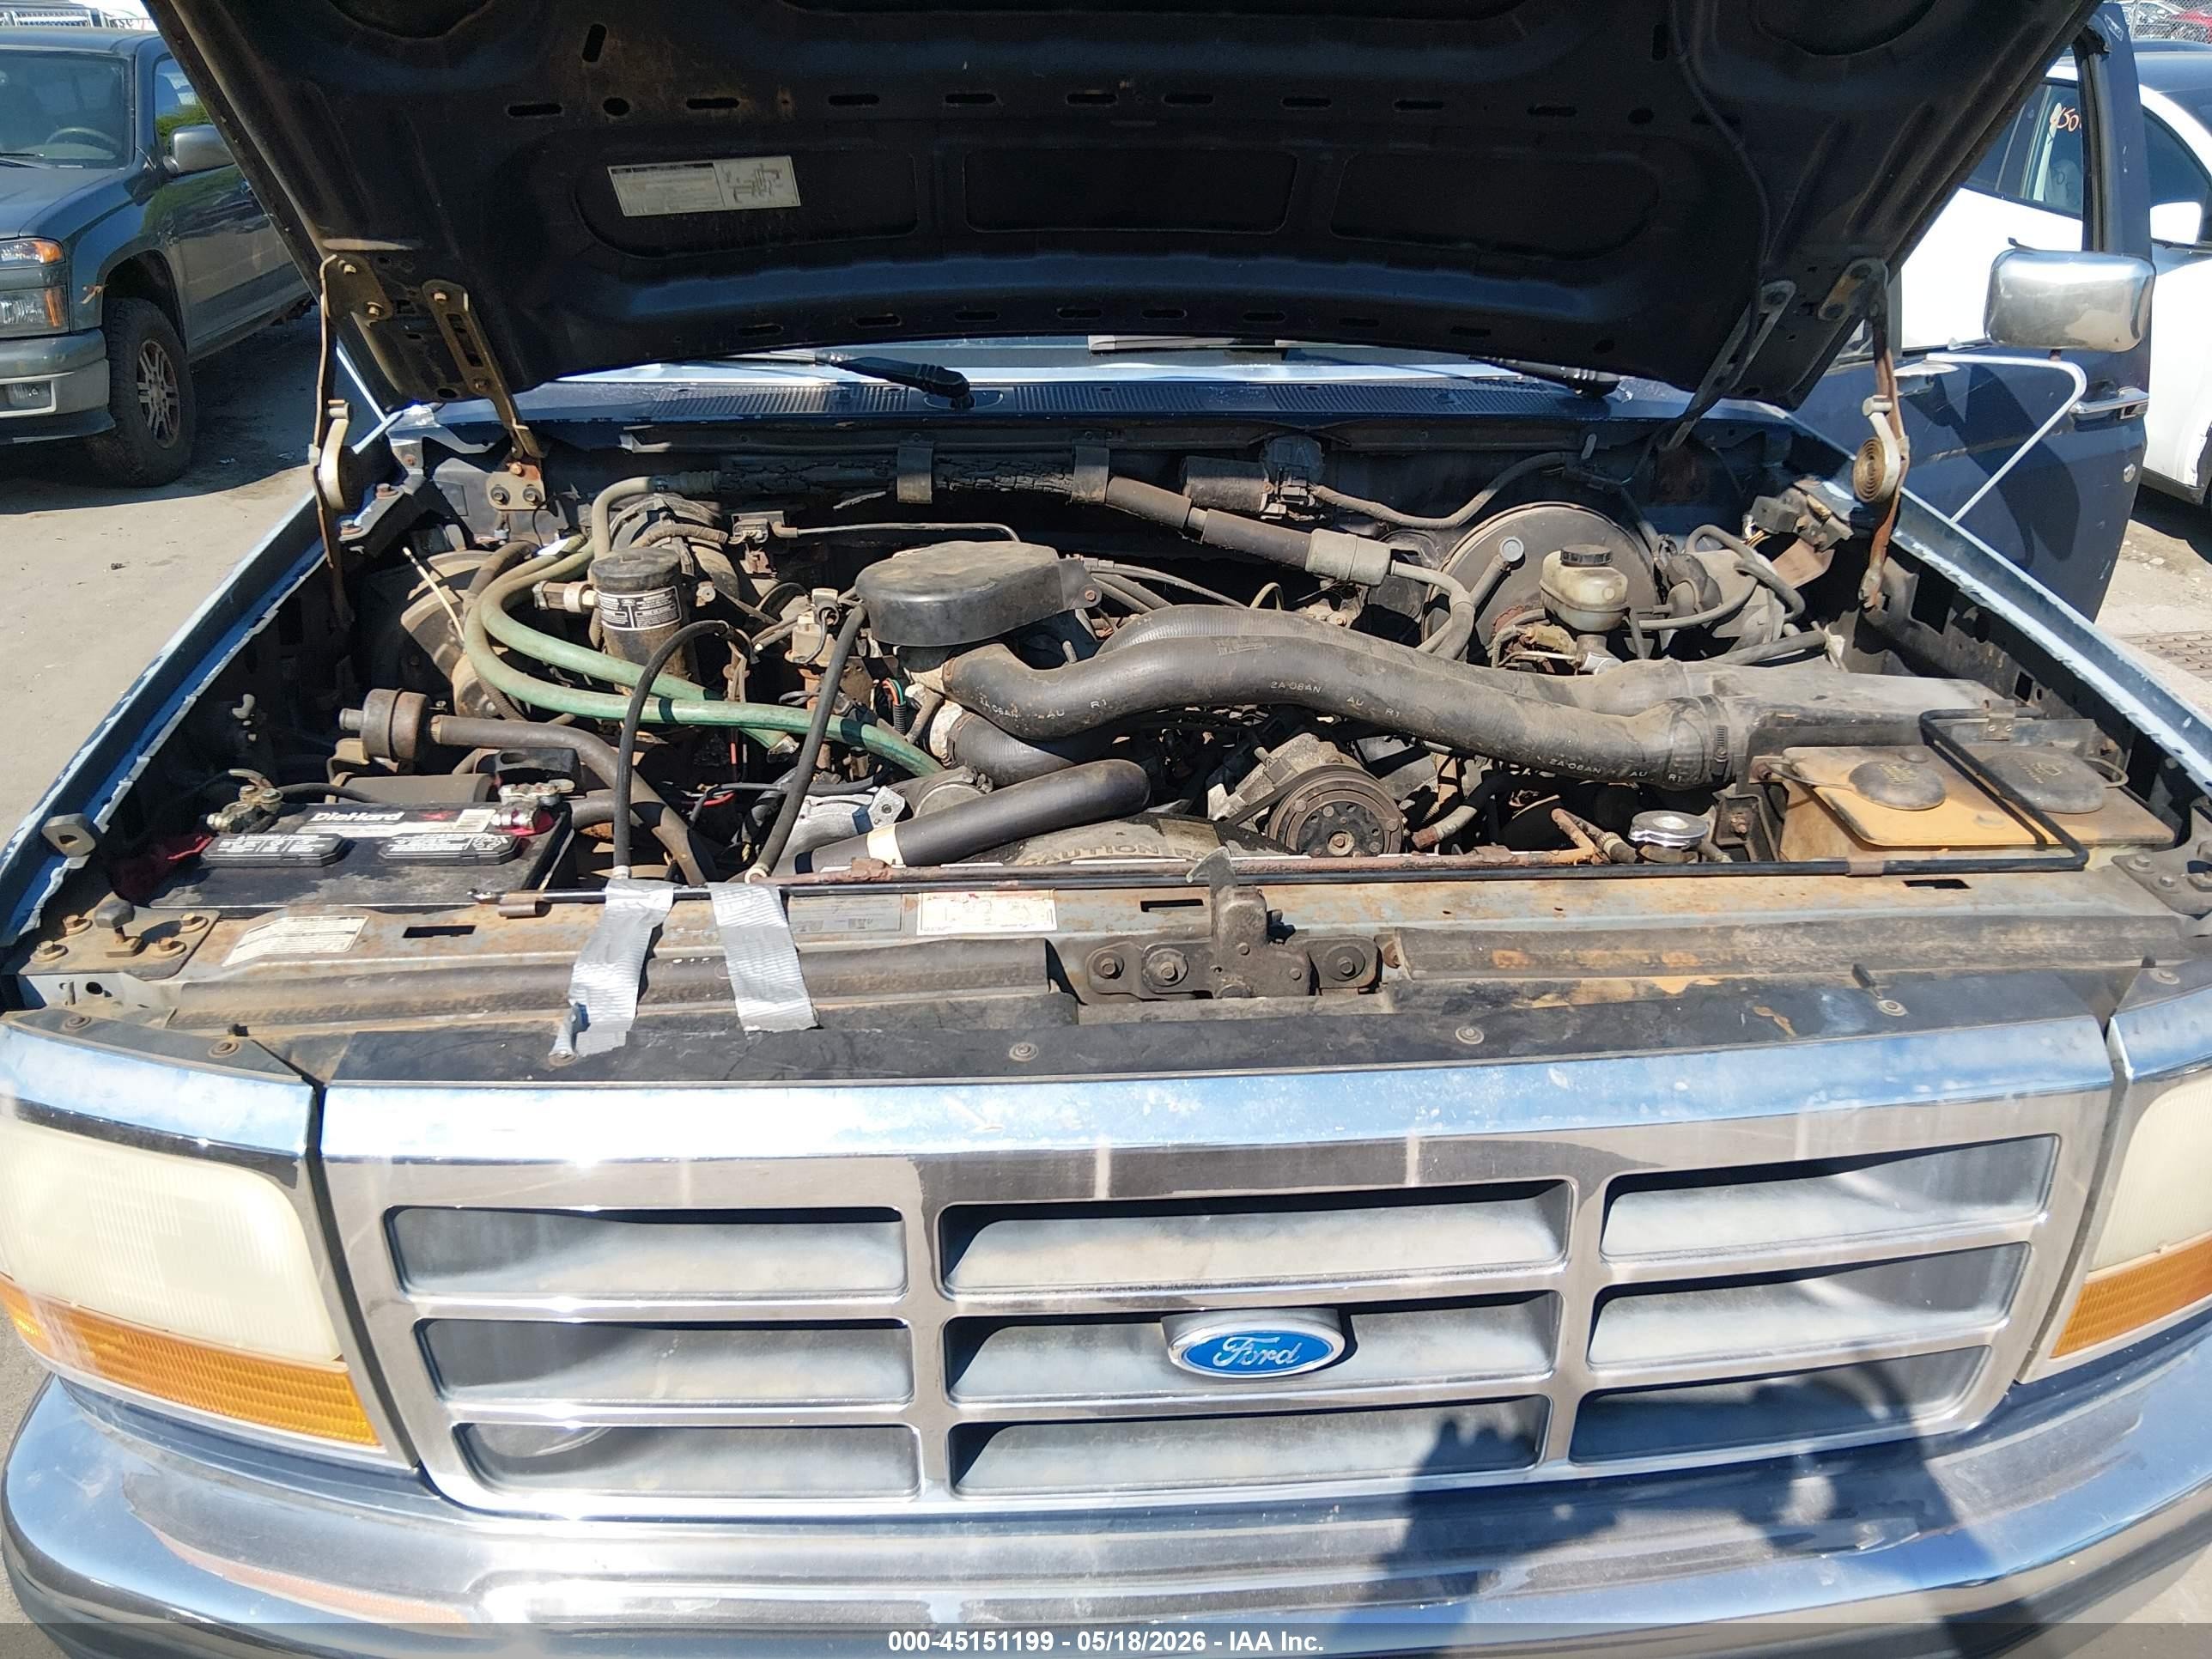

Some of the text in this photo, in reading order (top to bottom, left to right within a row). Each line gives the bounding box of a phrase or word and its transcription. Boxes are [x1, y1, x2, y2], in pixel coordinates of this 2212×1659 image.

[1346, 696, 1364, 707] AU
[310, 811, 405, 822] DieHard
[1212, 1335, 1303, 1367] Ford
